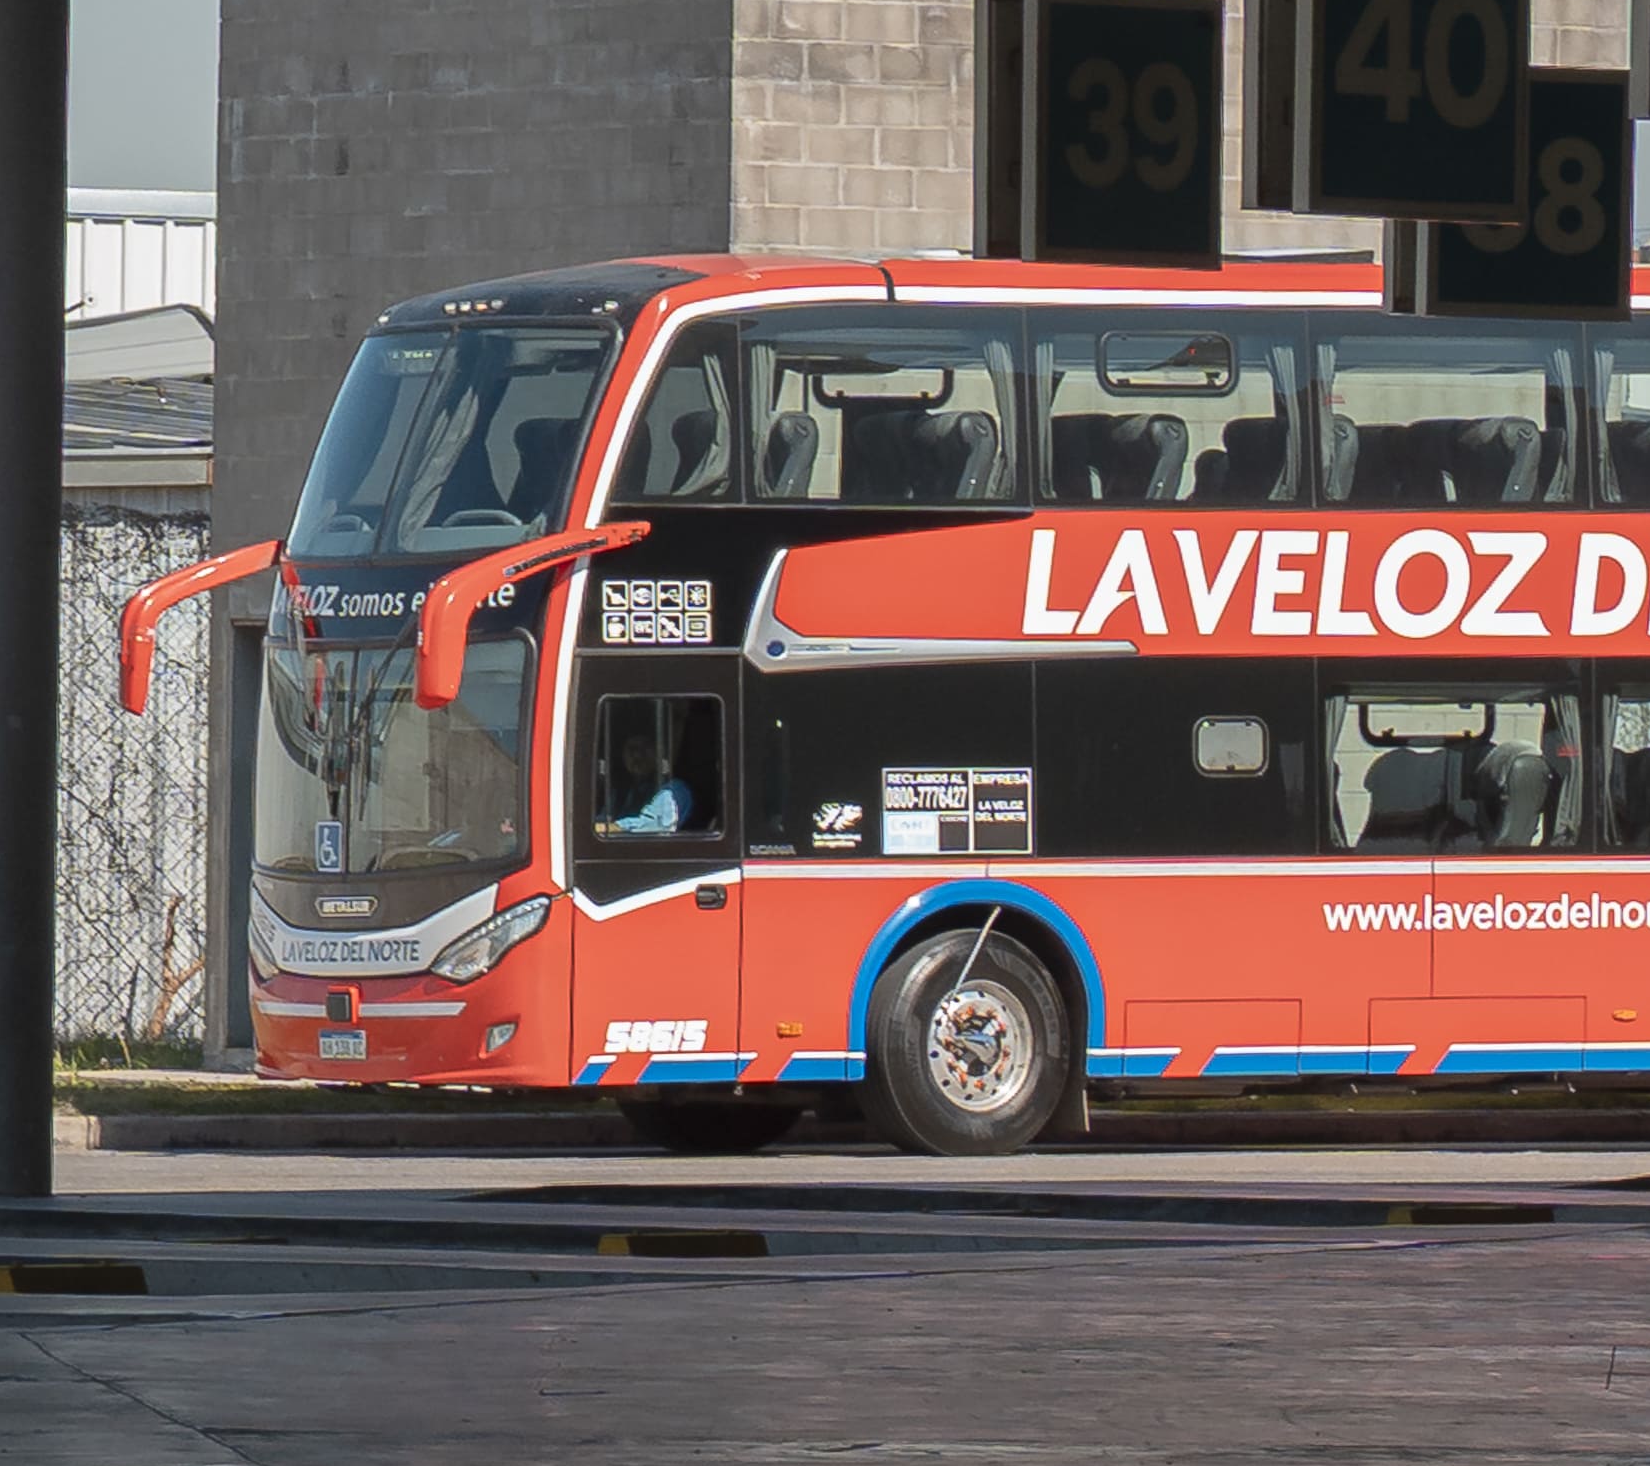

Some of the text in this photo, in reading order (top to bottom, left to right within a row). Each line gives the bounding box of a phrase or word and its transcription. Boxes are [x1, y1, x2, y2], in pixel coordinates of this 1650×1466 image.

[1065, 58, 1199, 193] 39
[340, 591, 406, 617] somos
[341, 940, 365, 963] DEL
[367, 940, 420, 962] NORTE
[604, 1019, 709, 1053] 58615
